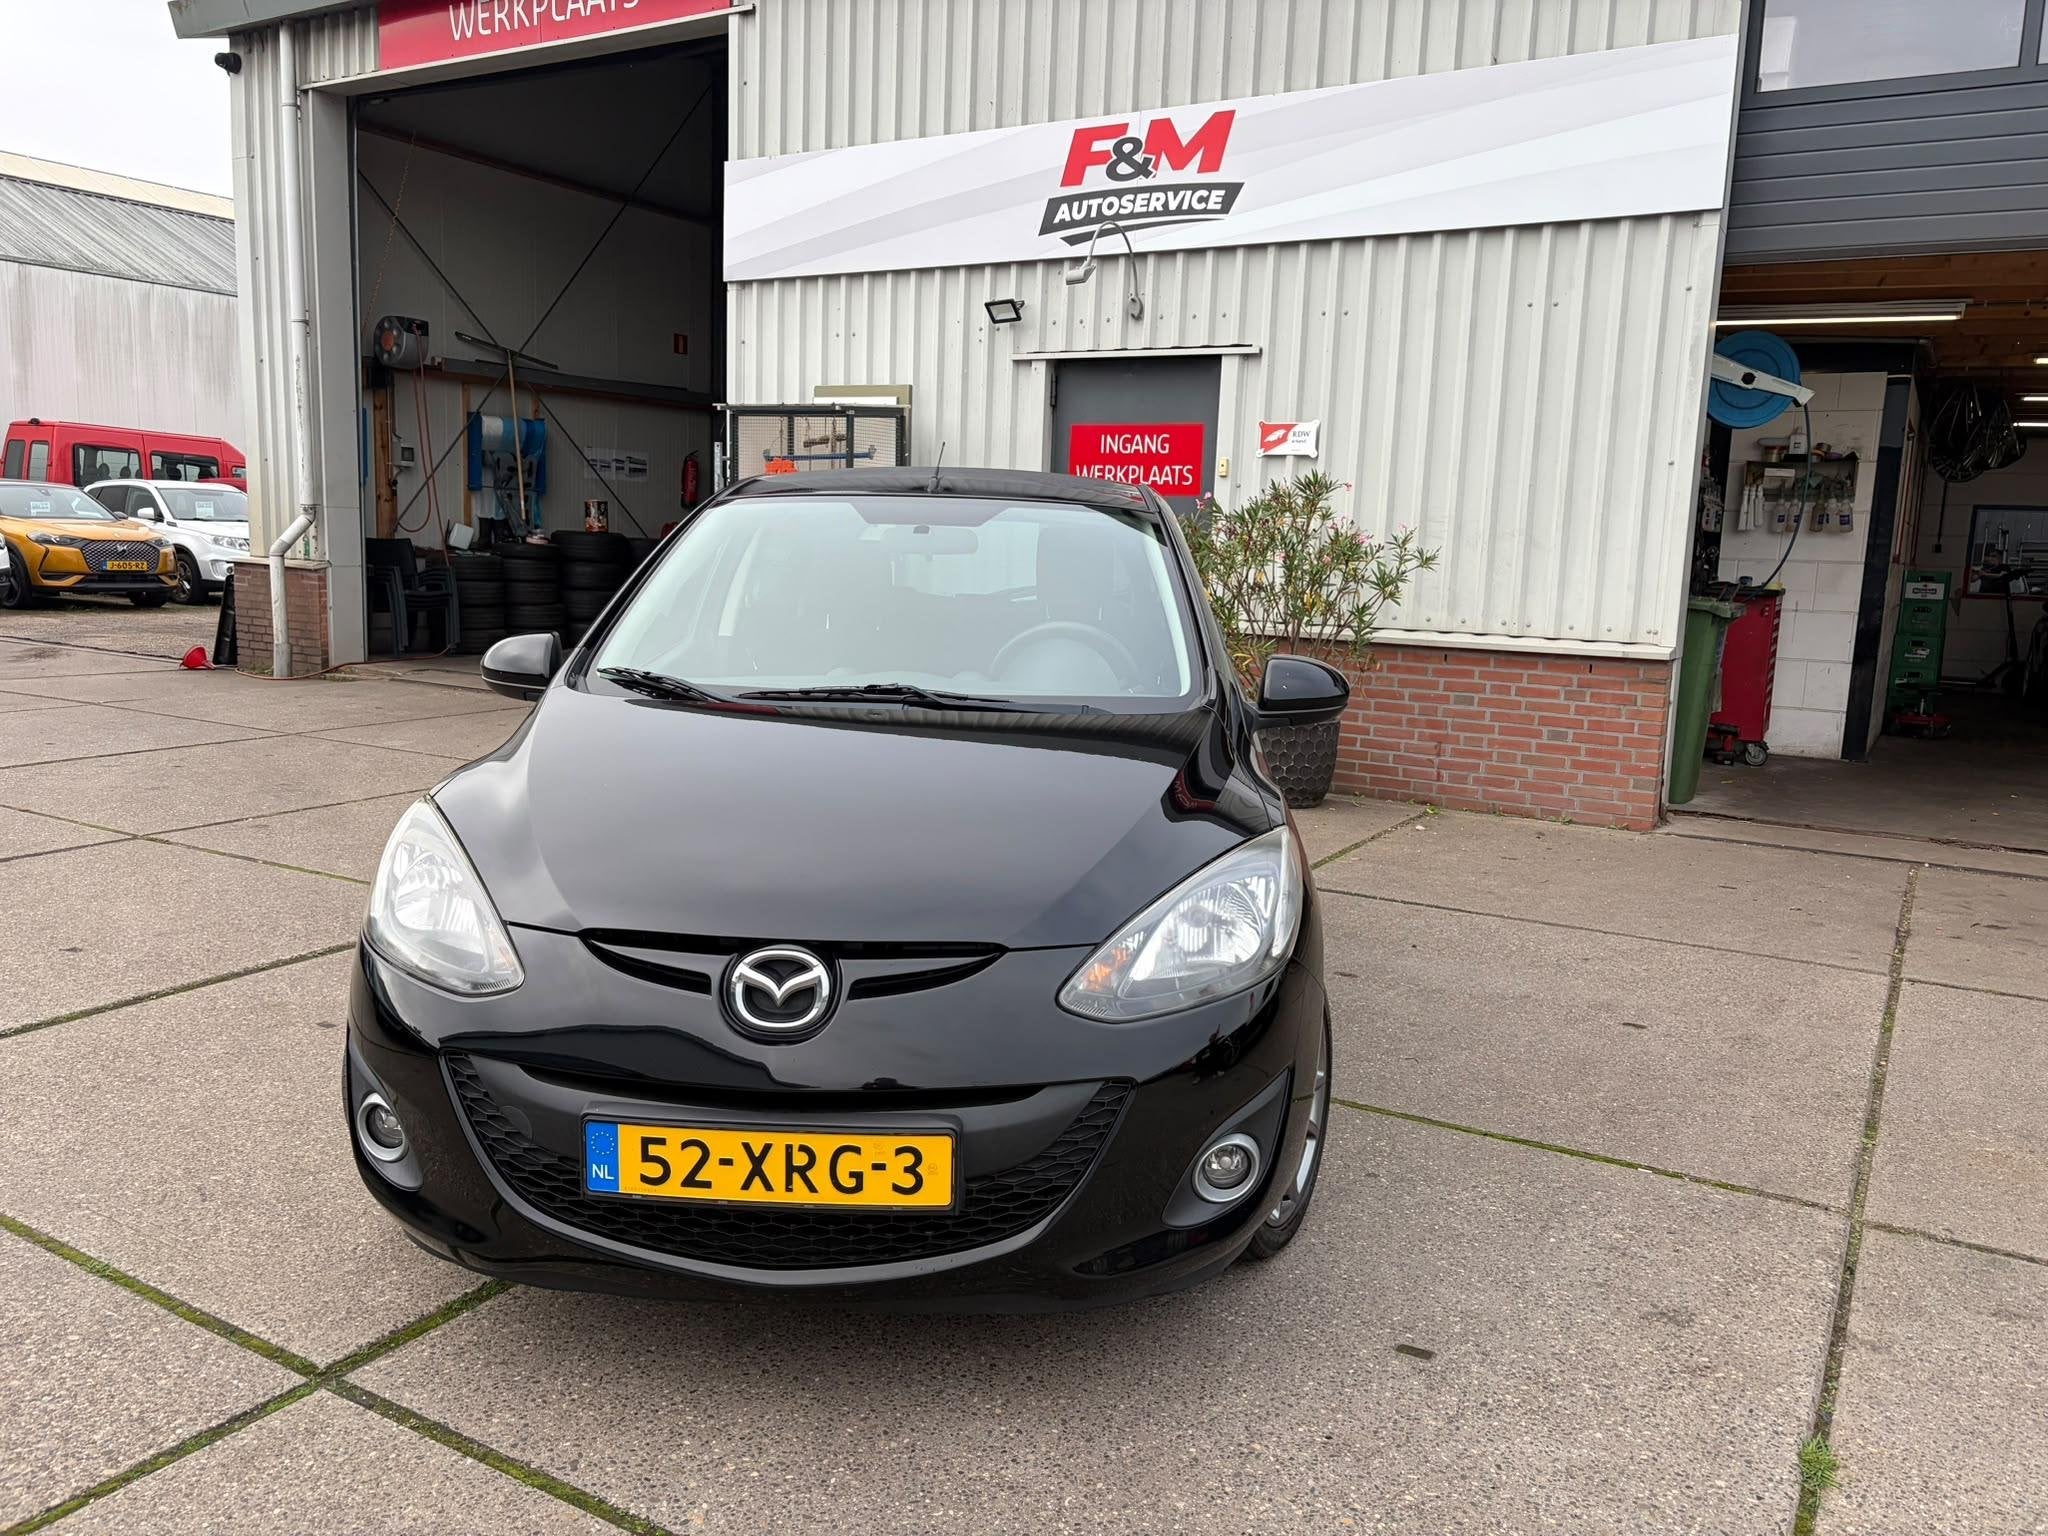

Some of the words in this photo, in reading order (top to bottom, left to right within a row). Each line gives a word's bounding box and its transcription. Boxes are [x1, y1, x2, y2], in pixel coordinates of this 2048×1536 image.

[449, 0, 639, 40] WERKPLA
[1060, 109, 1236, 187] F&M
[1052, 189, 1226, 224] AUTOSERVICE
[1100, 434, 1170, 454] INGANG
[1292, 430, 1311, 438] RDW
[1076, 465, 1193, 486] WERKPLAATS
[592, 1163, 614, 1181] NL
[639, 1136, 924, 1196] 52-XRG-3
